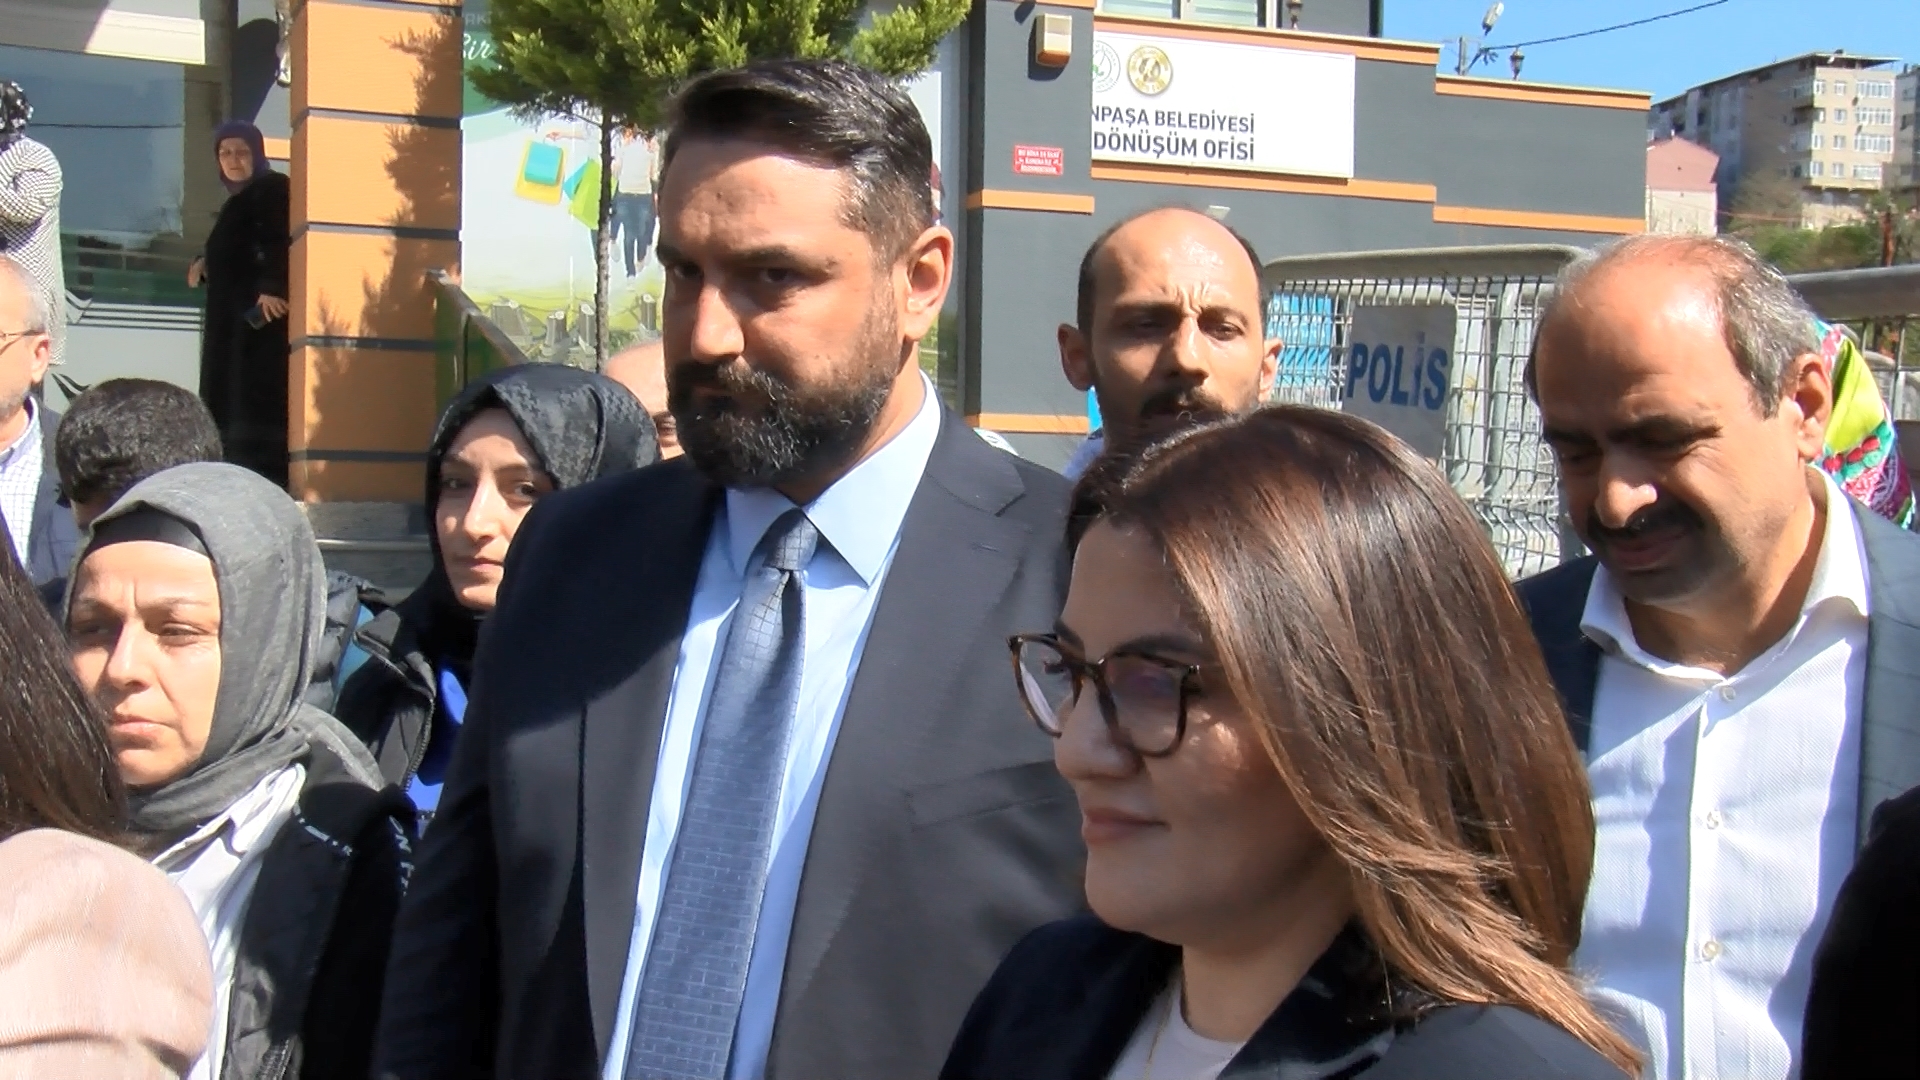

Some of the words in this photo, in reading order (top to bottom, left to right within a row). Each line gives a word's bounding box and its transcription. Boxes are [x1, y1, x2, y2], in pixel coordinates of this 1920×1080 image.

[1155, 109, 1254, 134] BELEDİYESİ
[1093, 127, 1197, 159] DÖNÜŞÜM
[1204, 135, 1254, 161] OFİSİ
[1346, 331, 1448, 410] POLİS
